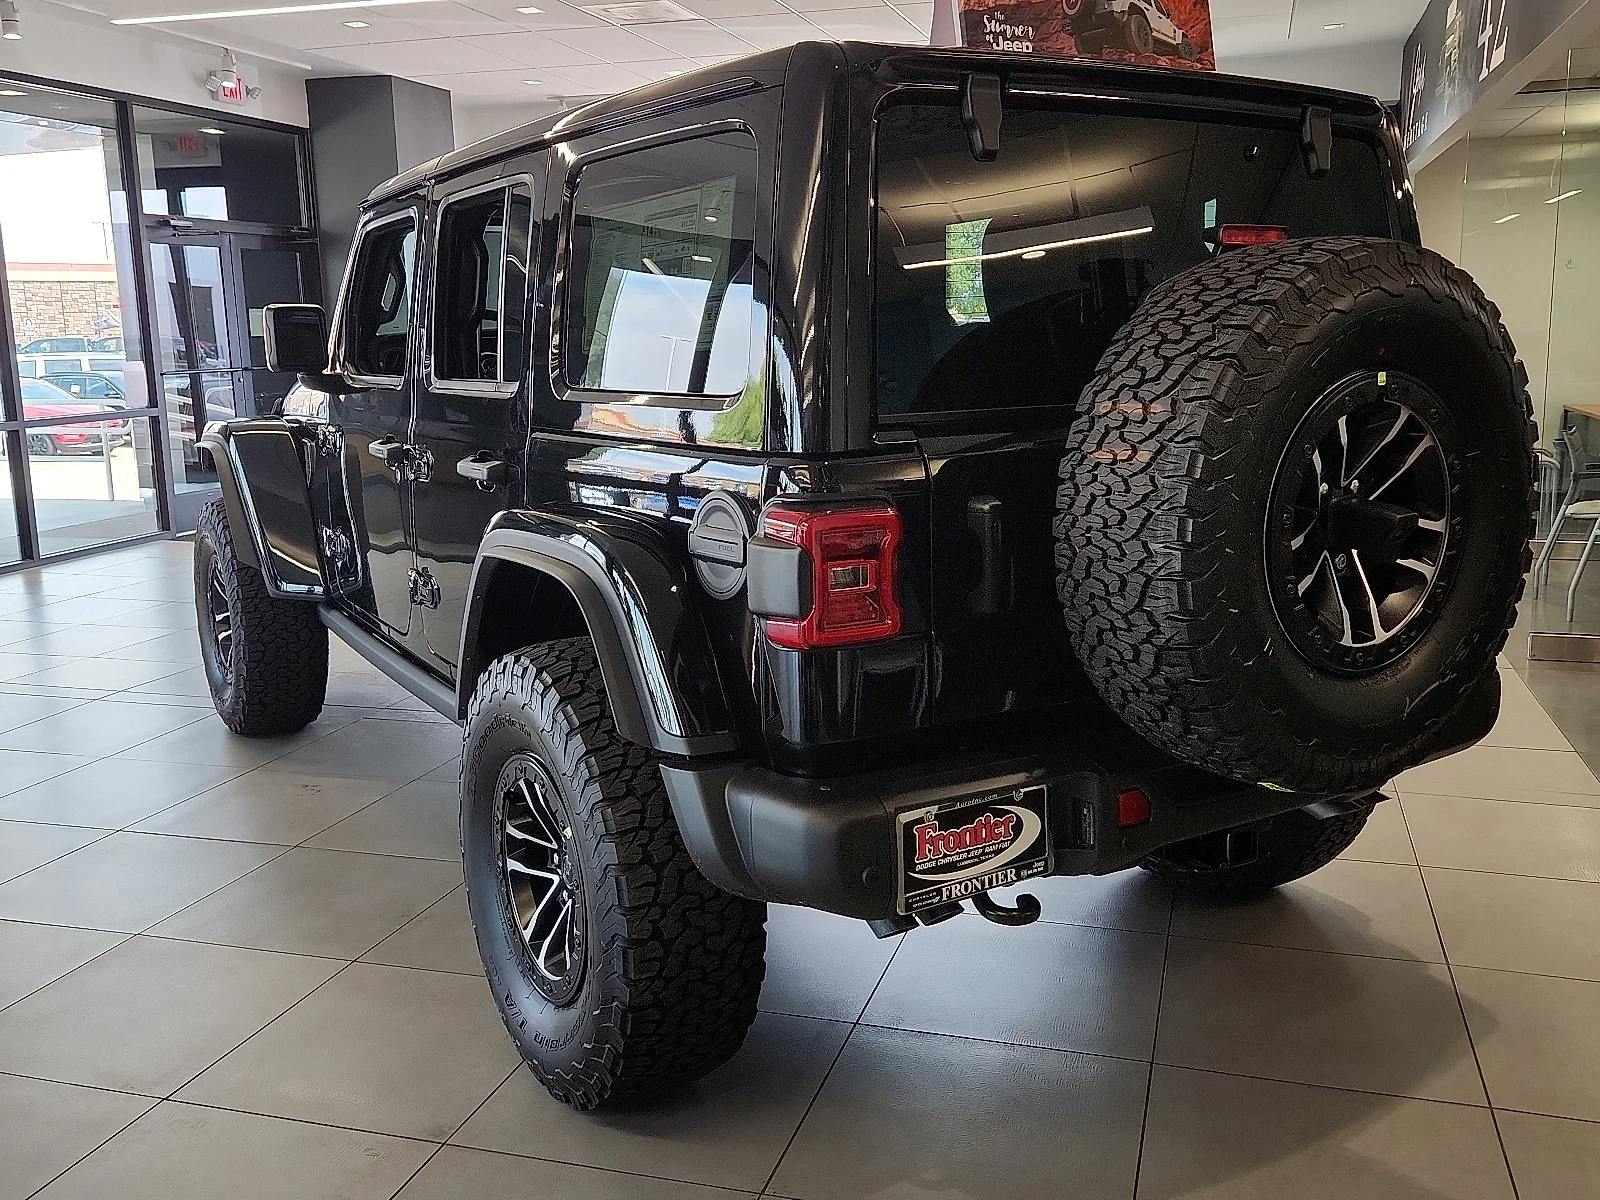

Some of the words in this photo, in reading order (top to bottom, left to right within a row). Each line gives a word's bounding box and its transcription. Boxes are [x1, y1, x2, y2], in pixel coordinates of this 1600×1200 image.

[983, 14, 1036, 40] Summer
[992, 35, 1033, 53] Jeep
[718, 544, 735, 553] FUEL
[913, 812, 1017, 863] Frontier
[915, 860, 937, 872] DODGE
[937, 852, 968, 866] CHRYSLER
[967, 848, 983, 858] JEEP
[941, 868, 1018, 901] FRONTIER
